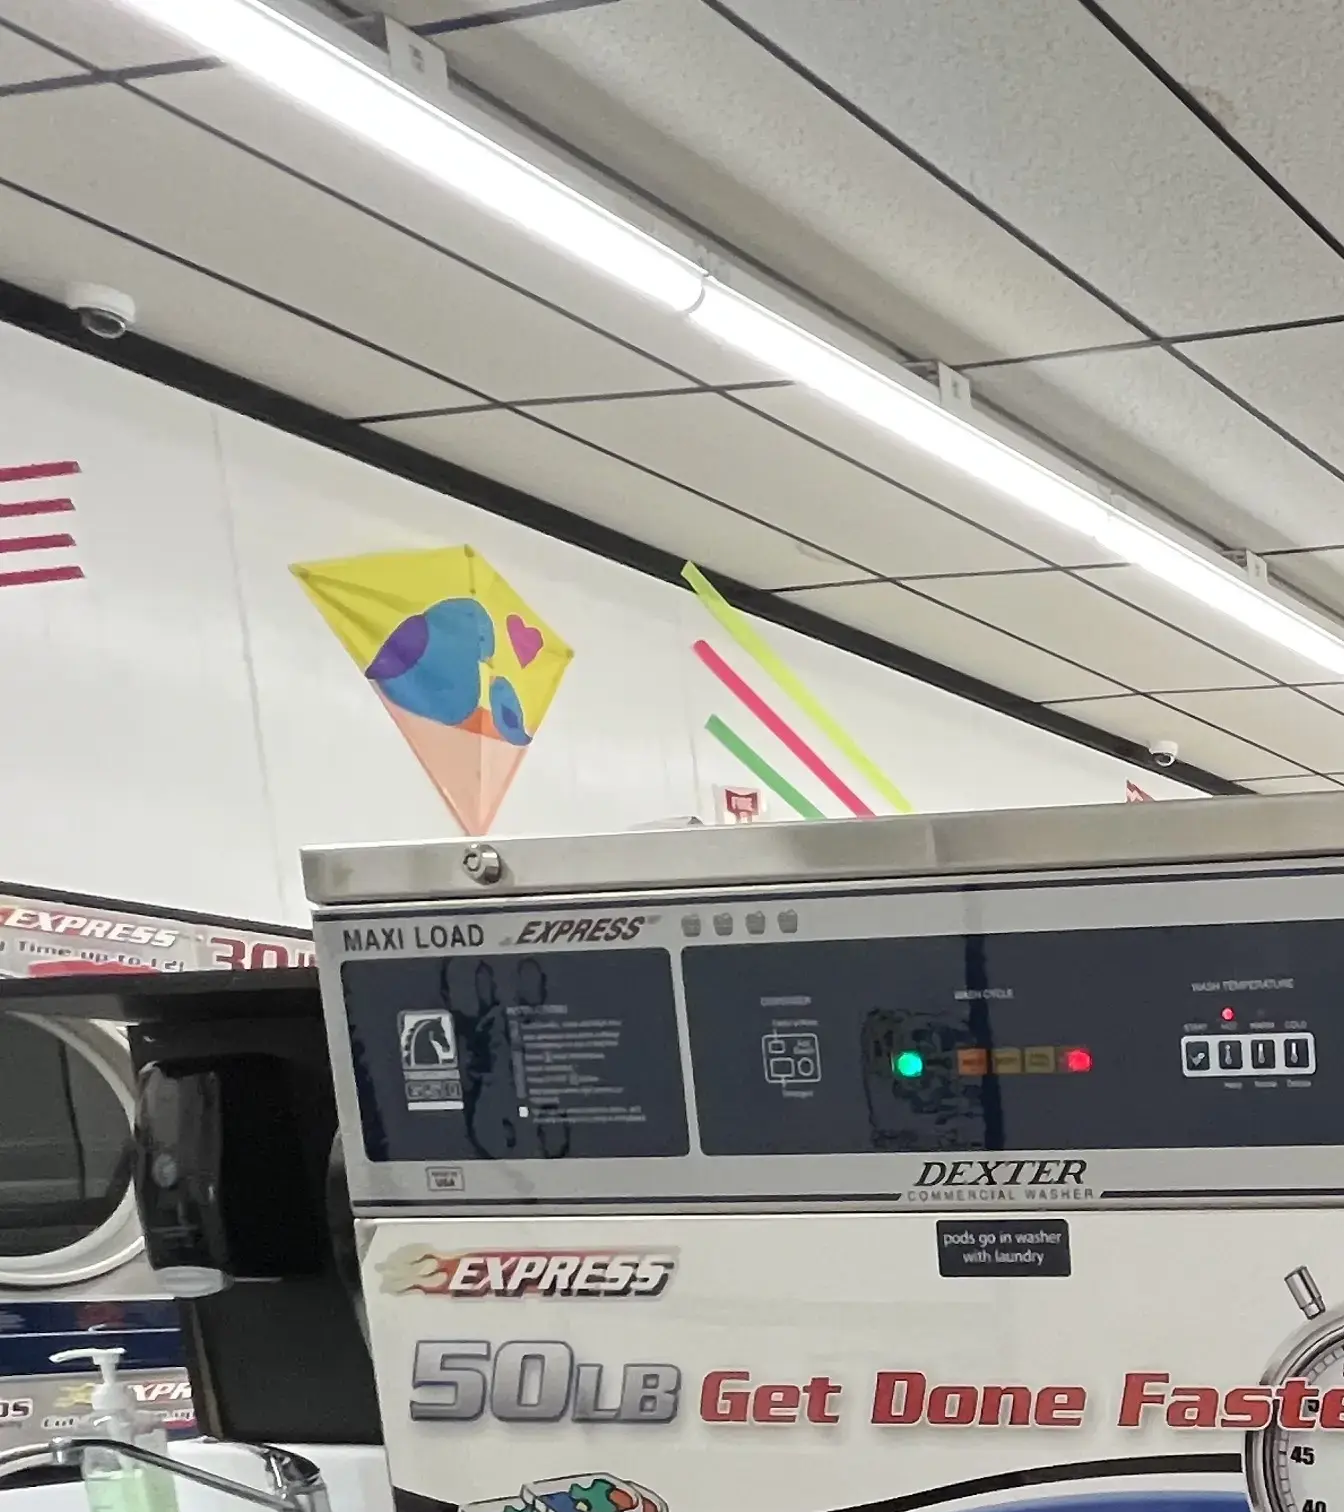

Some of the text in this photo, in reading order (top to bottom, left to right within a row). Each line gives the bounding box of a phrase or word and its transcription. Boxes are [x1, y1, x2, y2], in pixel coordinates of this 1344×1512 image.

[4, 908, 179, 948] EXPRESS
[343, 915, 646, 952] MAXI LOAD EXPRESS
[913, 1159, 1088, 1187] DEXTER
[907, 1187, 1094, 1201] COMMERCIAL WASHER
[943, 1228, 1062, 1248] pods go in washer
[962, 1248, 1045, 1266] with laundry
[447, 1254, 673, 1295] EXPRESS
[410, 1340, 683, 1424] 50LB
[701, 1371, 842, 1427] Get
[871, 1370, 1088, 1428] Done
[1290, 1445, 1315, 1466] 45
